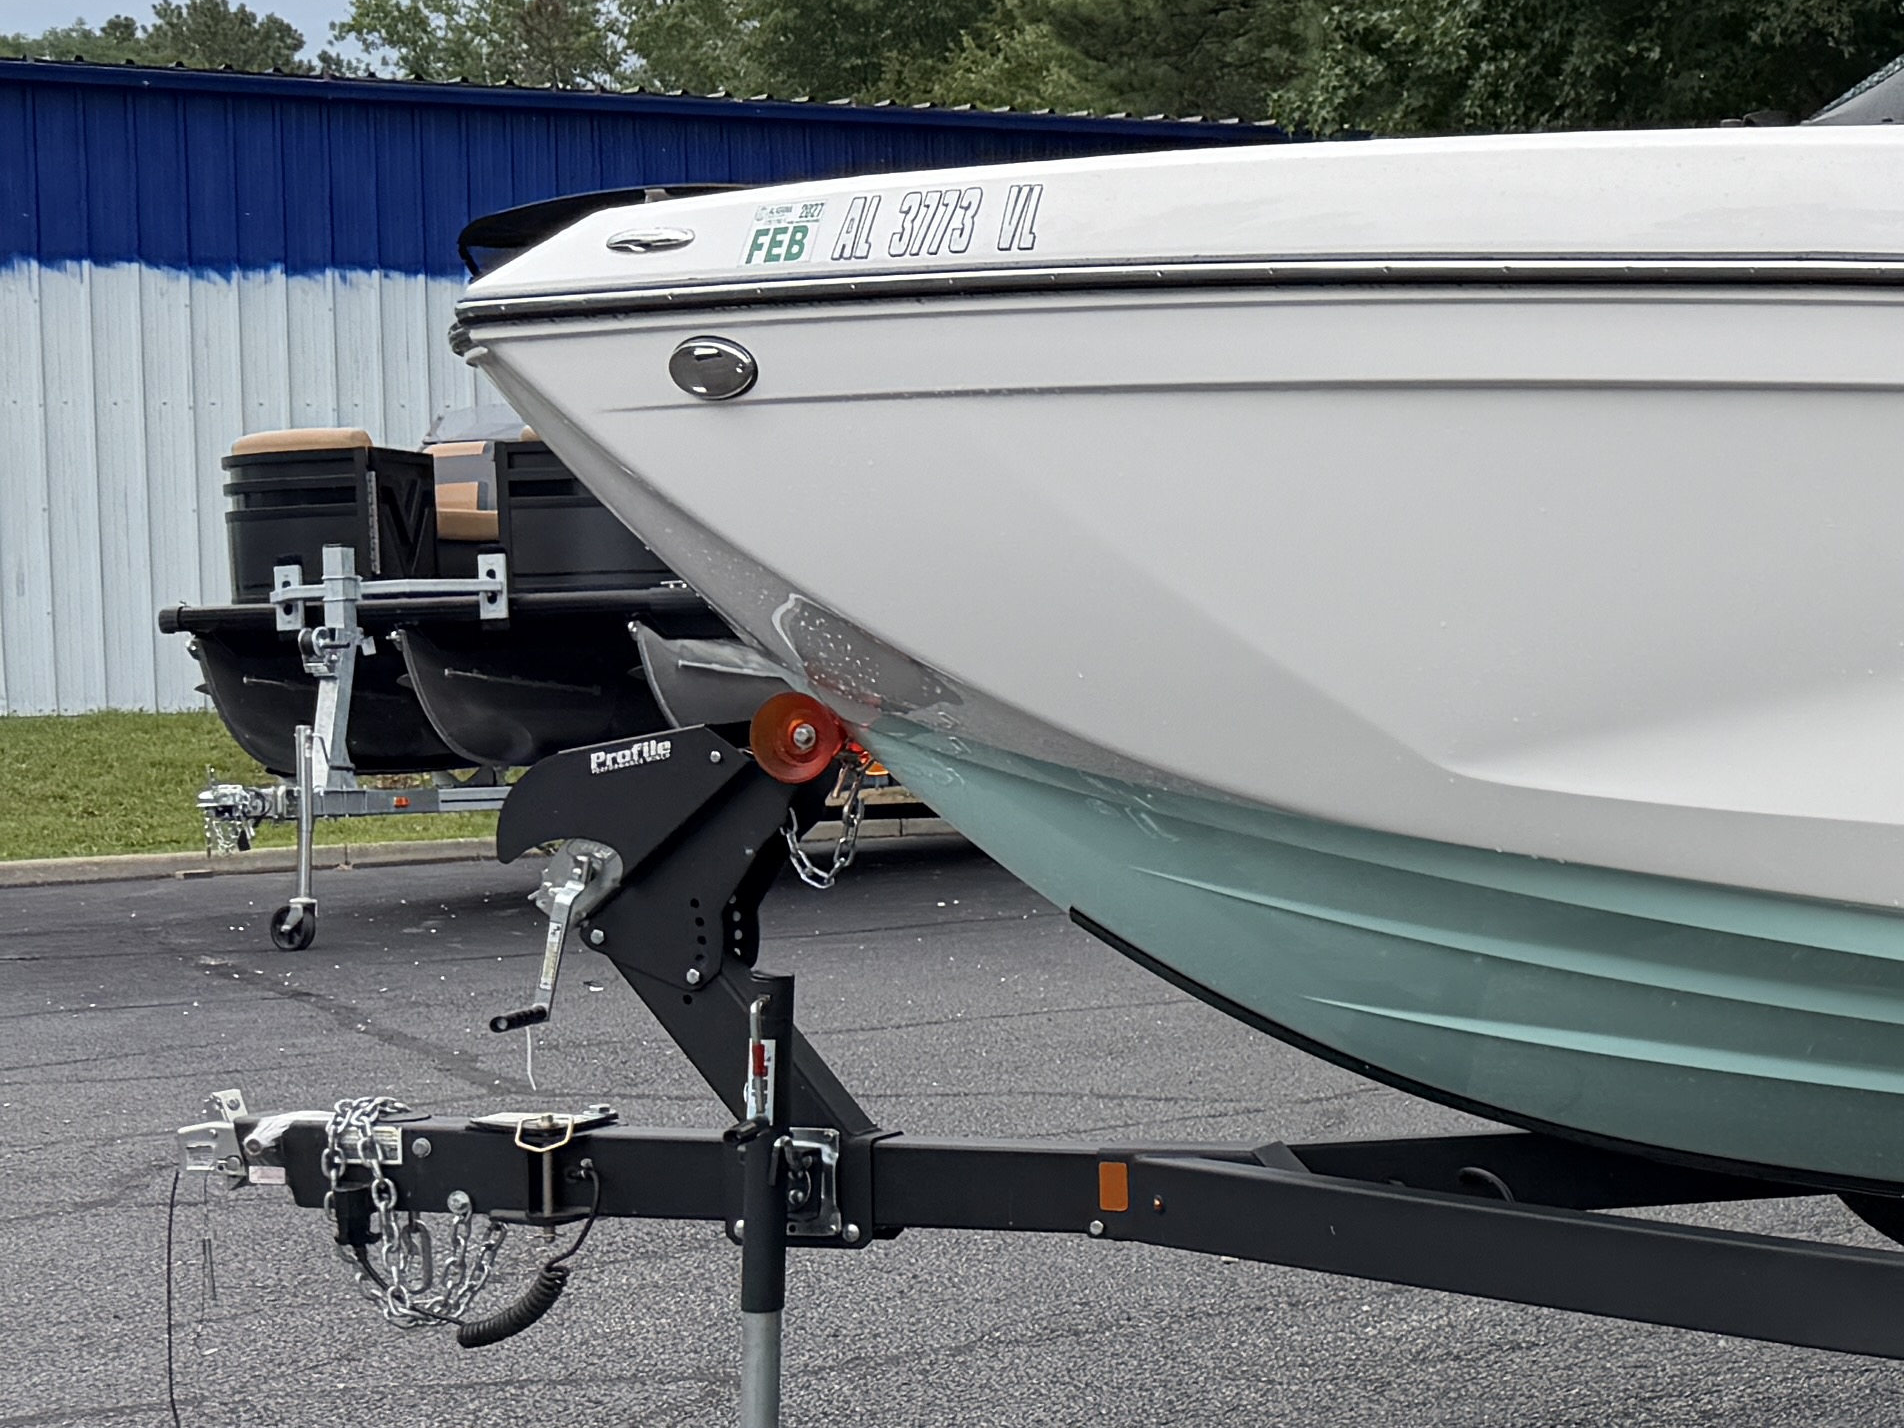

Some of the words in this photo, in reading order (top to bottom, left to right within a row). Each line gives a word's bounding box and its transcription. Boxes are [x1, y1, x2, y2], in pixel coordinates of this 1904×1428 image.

[831, 195, 881, 260] AL
[888, 187, 983, 257] 3773
[997, 184, 1044, 251] VL
[745, 225, 808, 264] FEB
[591, 740, 671, 771] Profile
